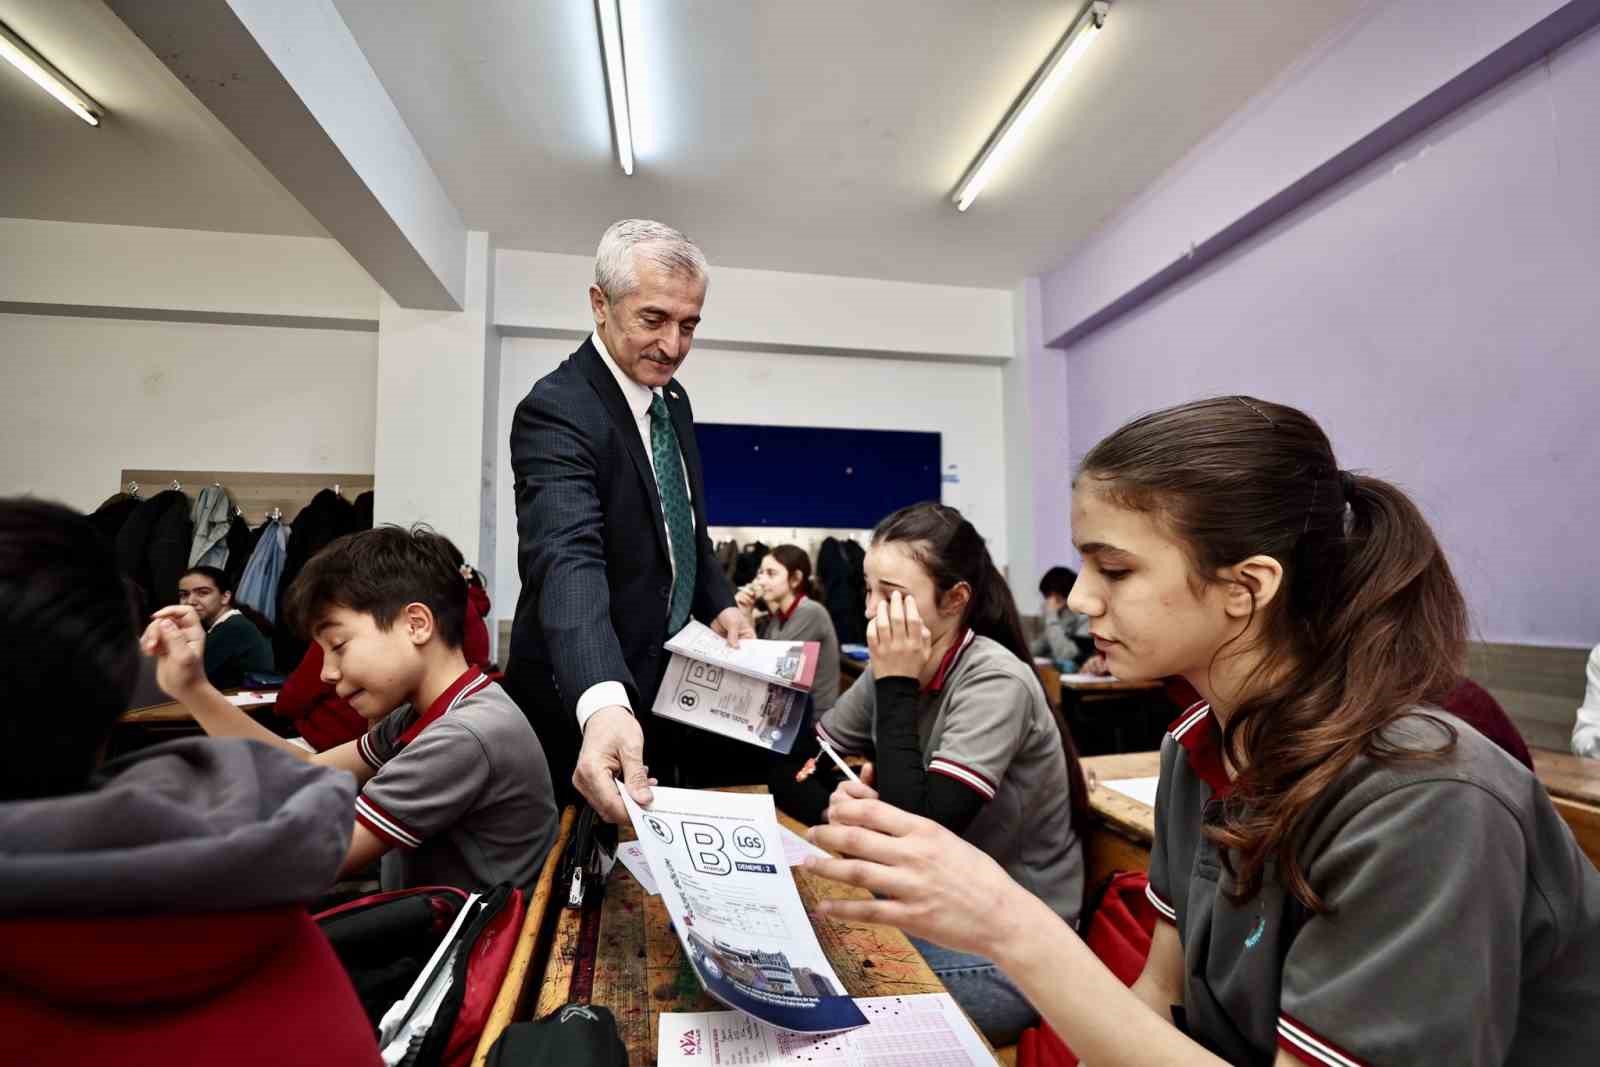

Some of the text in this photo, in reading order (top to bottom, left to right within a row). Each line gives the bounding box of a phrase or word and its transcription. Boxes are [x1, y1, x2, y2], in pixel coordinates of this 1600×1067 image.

[681, 695, 695, 707] 8
[681, 821, 732, 877] B
[737, 835, 761, 849] LGS
